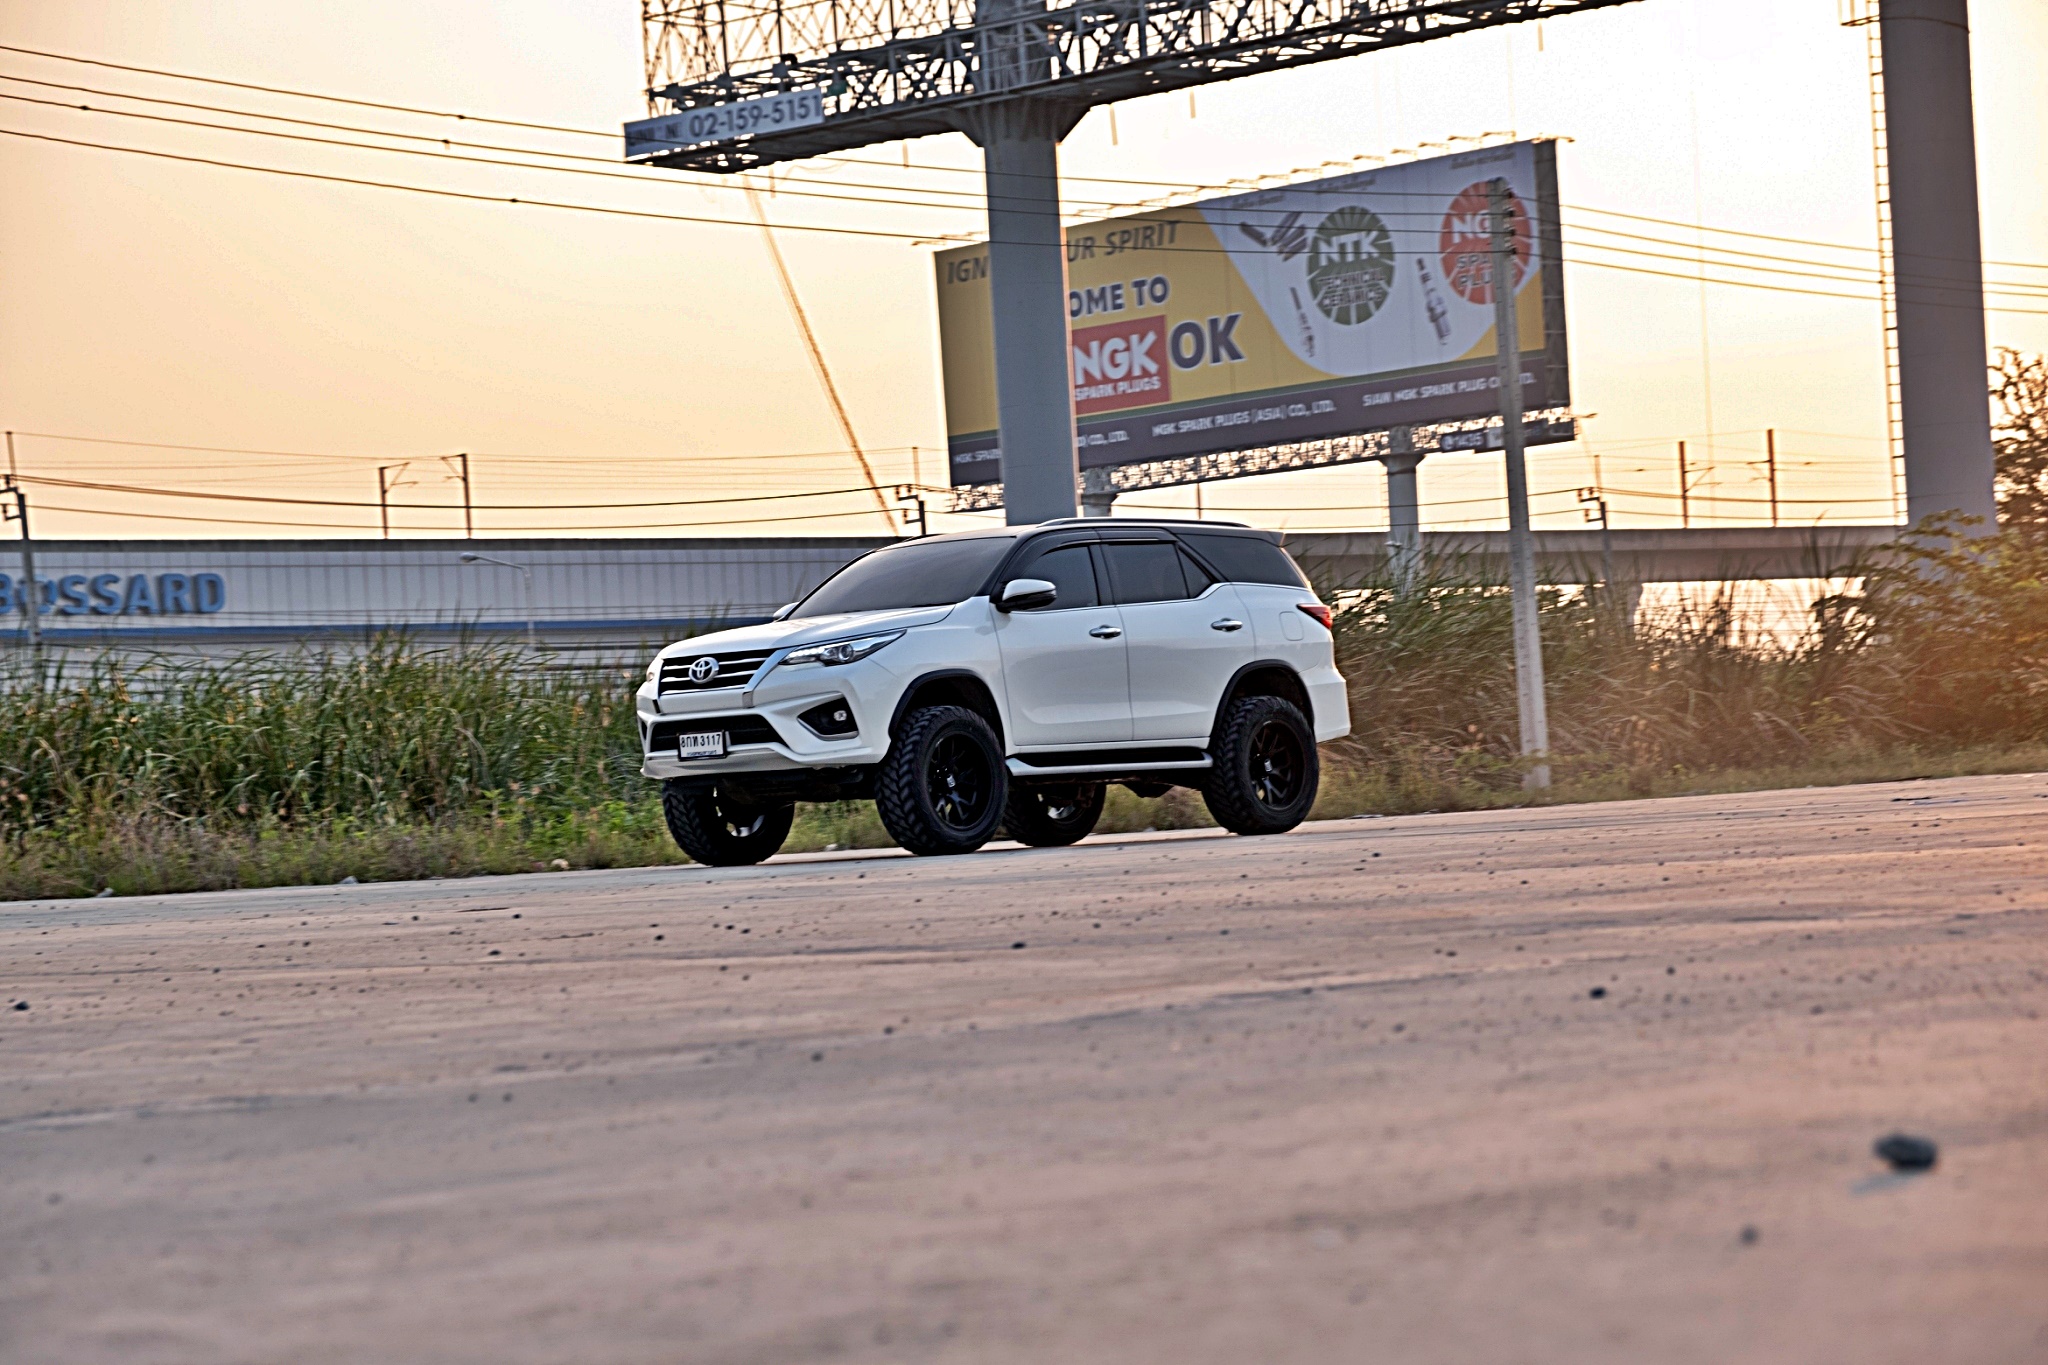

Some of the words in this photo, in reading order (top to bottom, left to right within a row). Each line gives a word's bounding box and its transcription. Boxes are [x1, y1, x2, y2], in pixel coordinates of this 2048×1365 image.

[689, 94, 822, 138] 02-159-5151
[1453, 209, 1493, 244] NG
[946, 255, 989, 284] IGN
[1103, 220, 1181, 257] SPIRIT
[1319, 230, 1379, 266] NTK
[1131, 275, 1169, 308] TO
[1316, 266, 1386, 289] TECHNICAL
[1074, 330, 1160, 385] NGK
[1170, 314, 1245, 370] OK
[1074, 382, 1116, 401] SPARK
[1116, 375, 1161, 395] PLUGS
[1362, 391, 1391, 407] SIAM
[1393, 388, 1420, 402] NGK
[1420, 383, 1455, 400] SPARK
[1457, 378, 1487, 394] PLUG
[1152, 422, 1178, 437] NGK
[1177, 416, 1214, 433] SPARK
[1214, 410, 1250, 428] PLUGS
[699, 733, 721, 747] 3117
